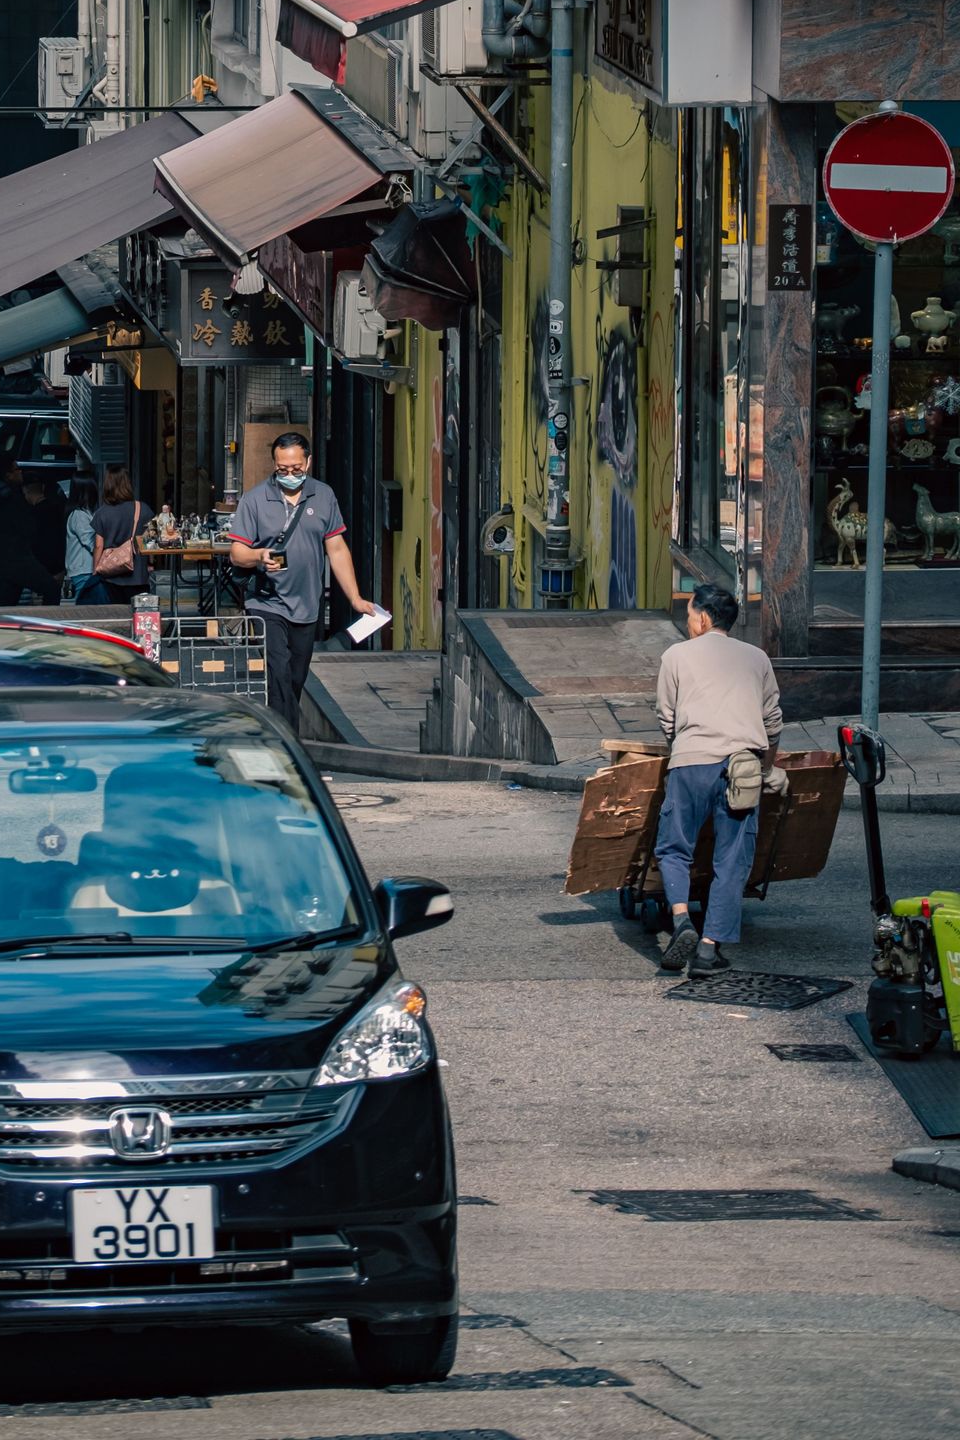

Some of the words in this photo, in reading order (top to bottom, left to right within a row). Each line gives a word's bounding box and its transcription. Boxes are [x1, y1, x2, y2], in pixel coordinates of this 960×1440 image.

[782, 208, 800, 273] 荷李活道
[192, 319, 304, 347] 冷熱飲
[115, 1188, 171, 1223] YX
[93, 1223, 195, 1259] 3901
